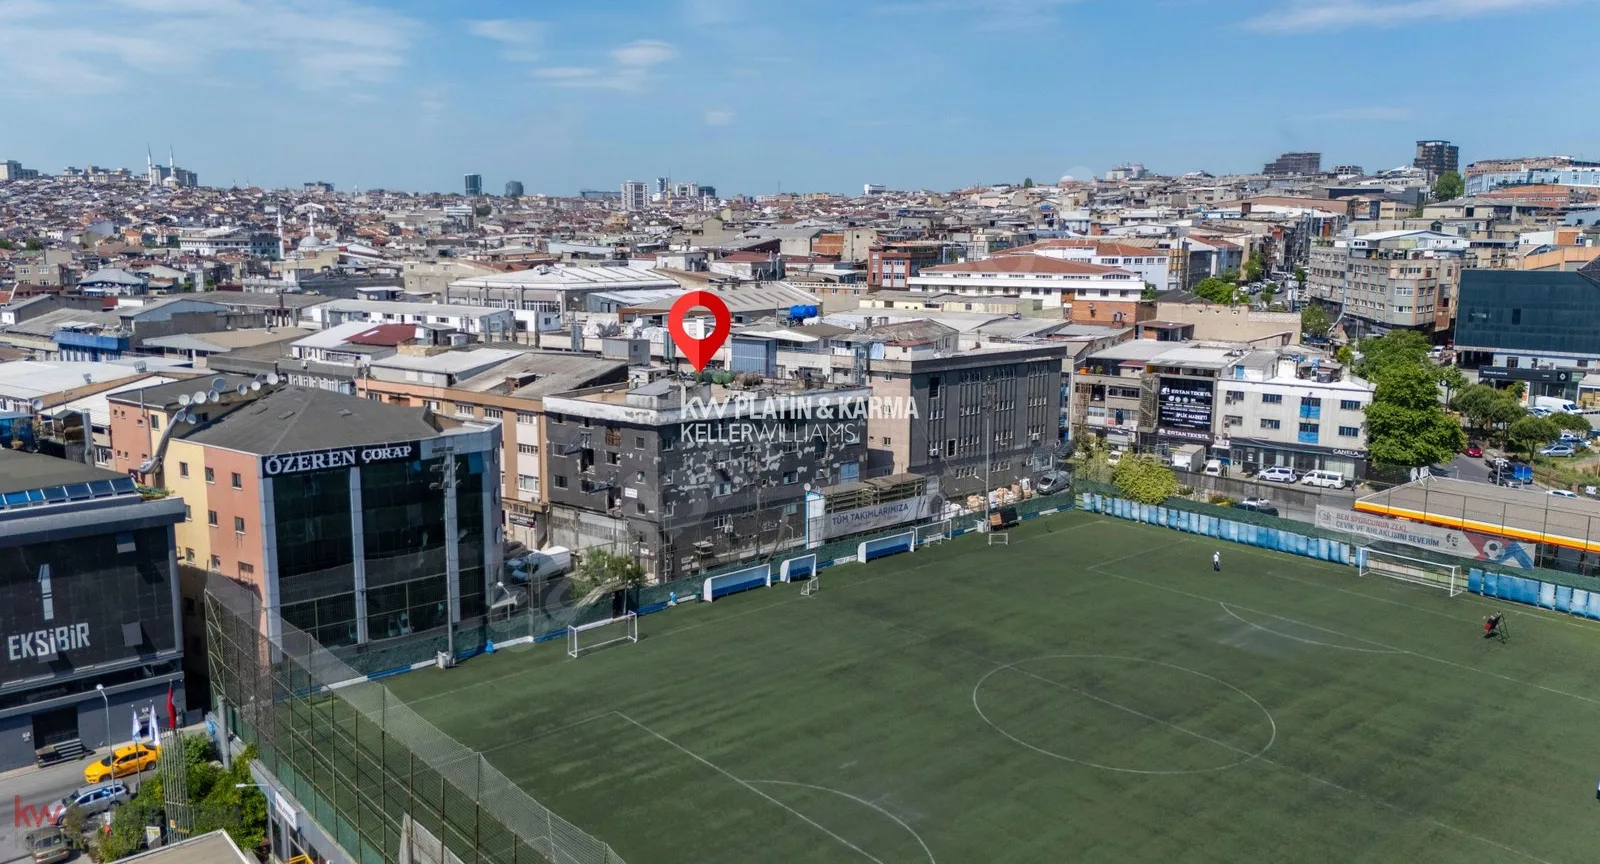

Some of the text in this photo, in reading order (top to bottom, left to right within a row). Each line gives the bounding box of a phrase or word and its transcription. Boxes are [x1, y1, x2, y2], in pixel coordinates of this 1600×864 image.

[265, 445, 412, 475] ÖZEREN ÇORAP
[832, 515, 849, 525] TÜM
[1335, 513, 1349, 521] BEN
[1350, 515, 1389, 529] SPORCUNUN
[1356, 524, 1364, 532] VE
